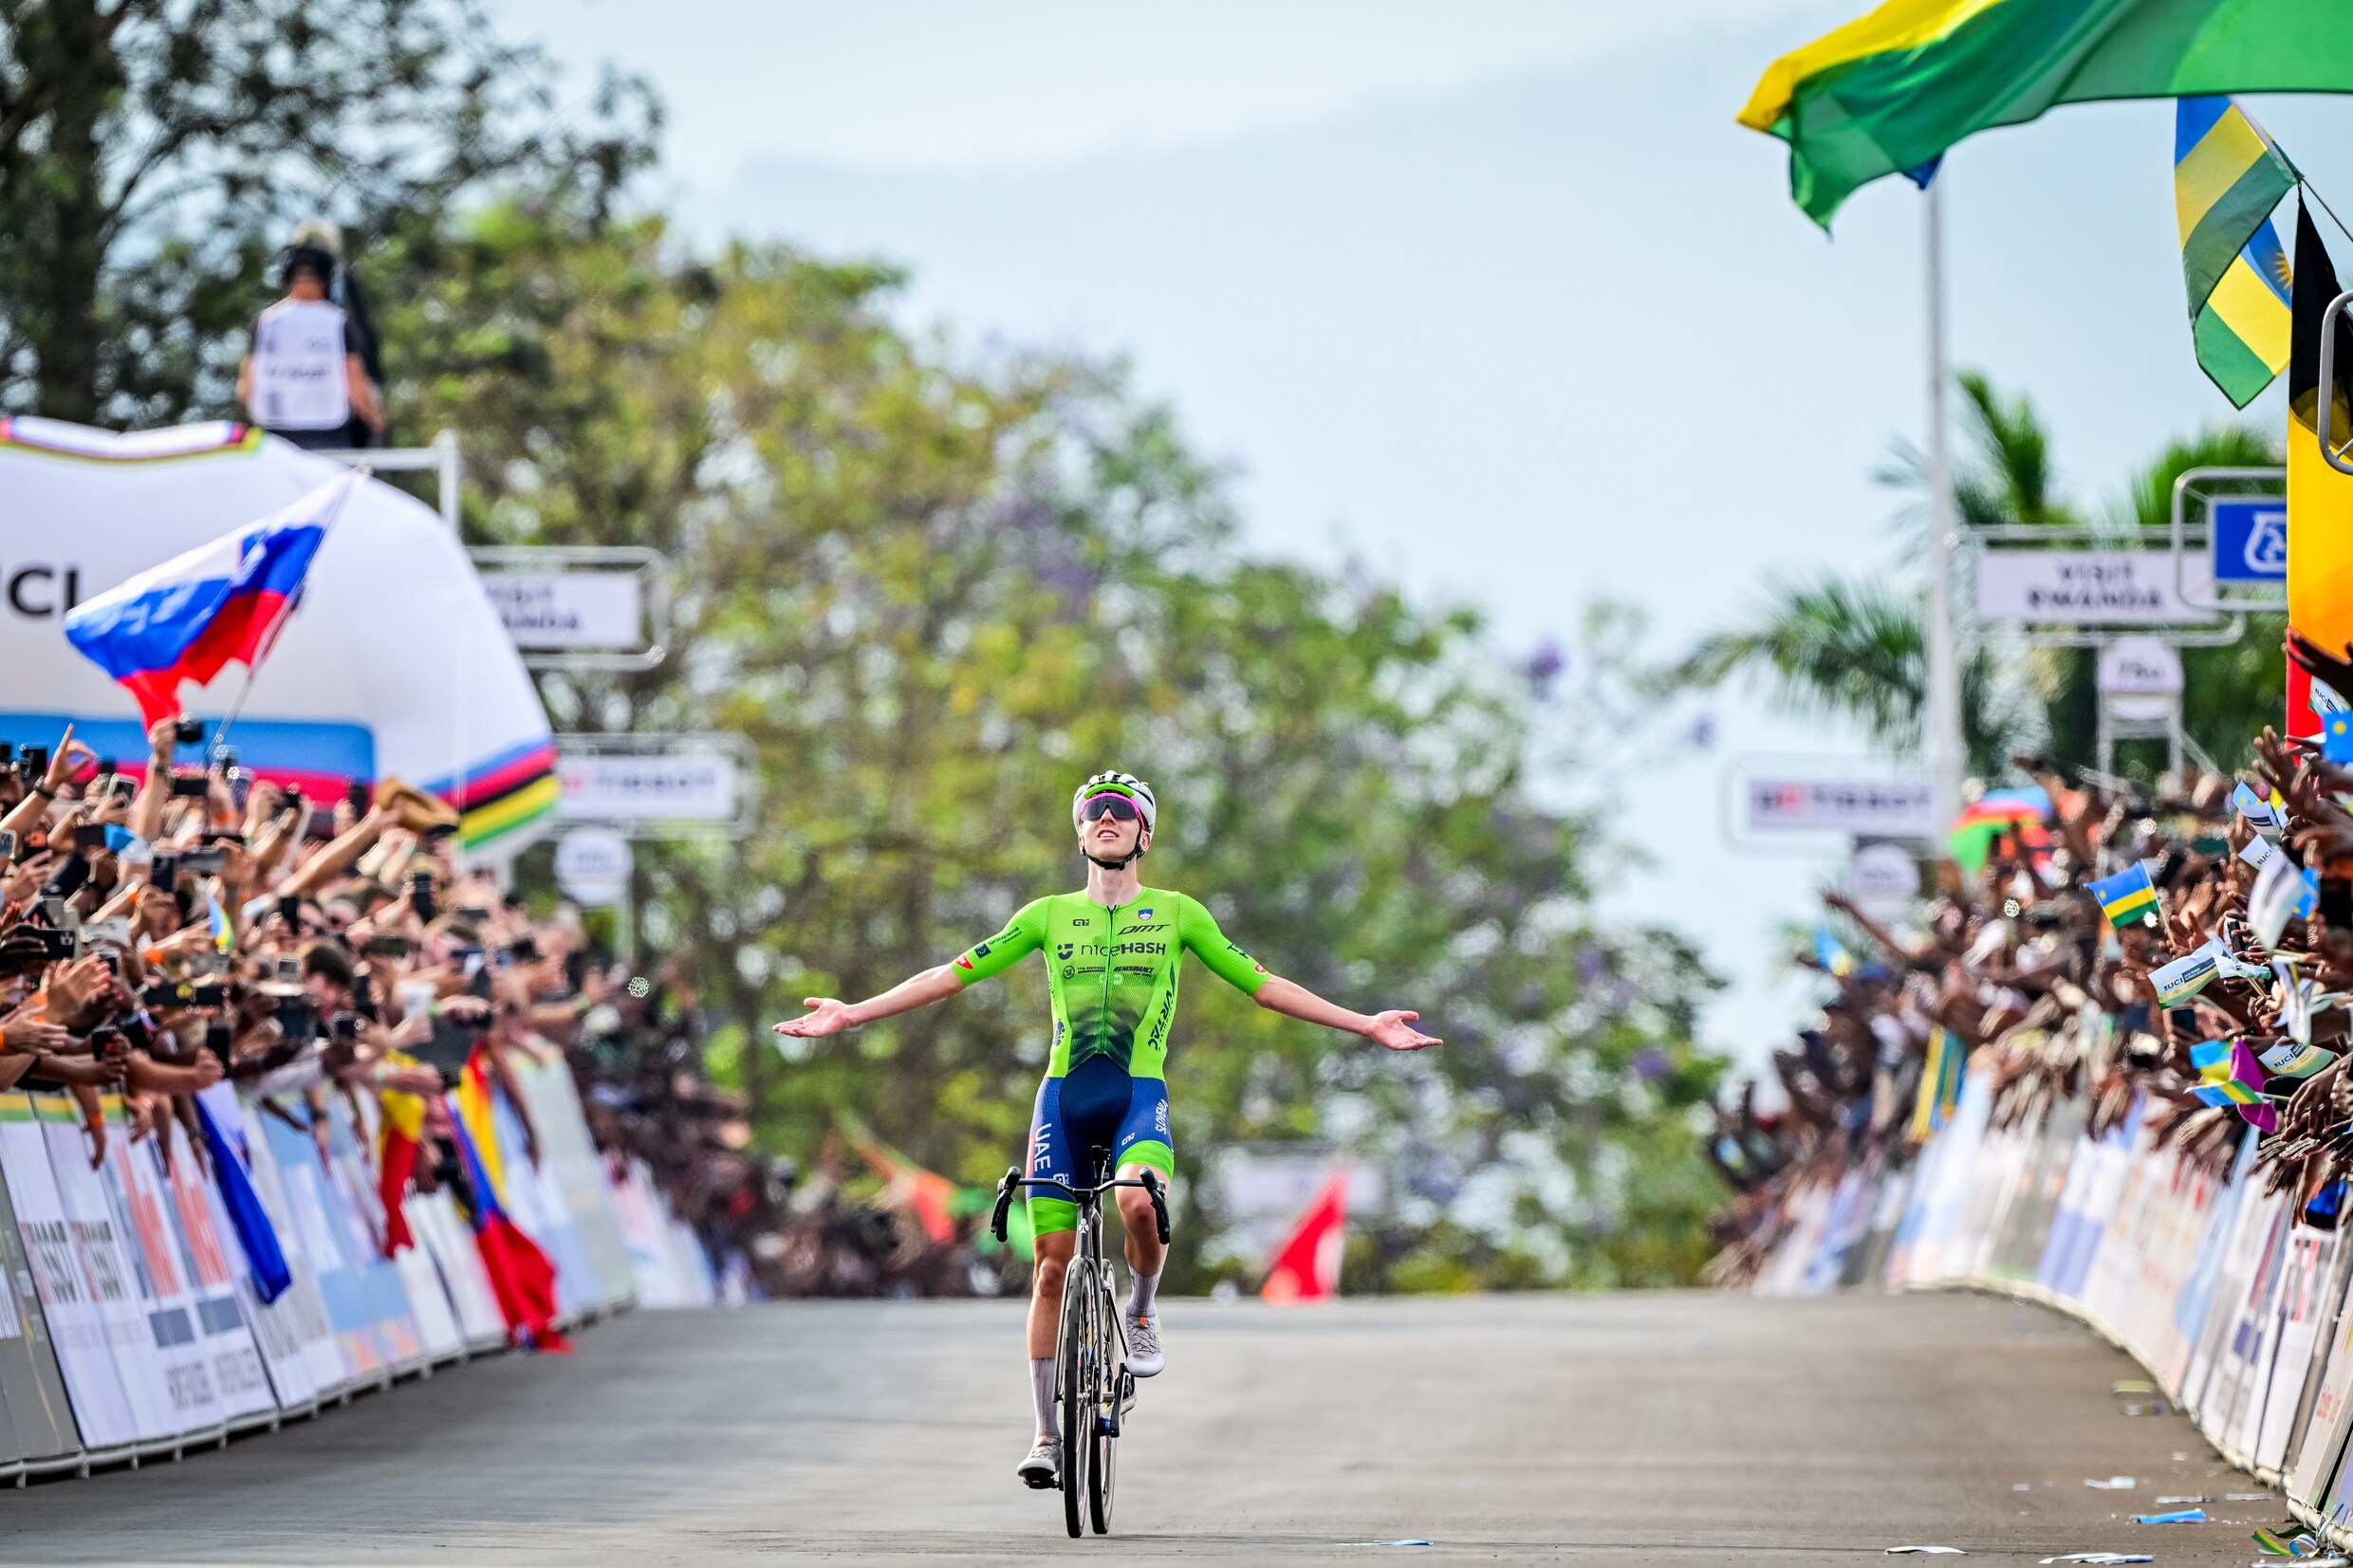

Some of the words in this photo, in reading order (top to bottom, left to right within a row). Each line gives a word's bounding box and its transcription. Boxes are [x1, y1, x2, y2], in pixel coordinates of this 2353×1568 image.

[0, 565, 80, 618] CI
[484, 584, 553, 603] ISIT
[2025, 585, 2164, 609] RWANDA
[501, 611, 582, 630] ANDA
[1155, 1098, 1168, 1135] SLOVENIA
[1034, 1122, 1052, 1172] UAE
